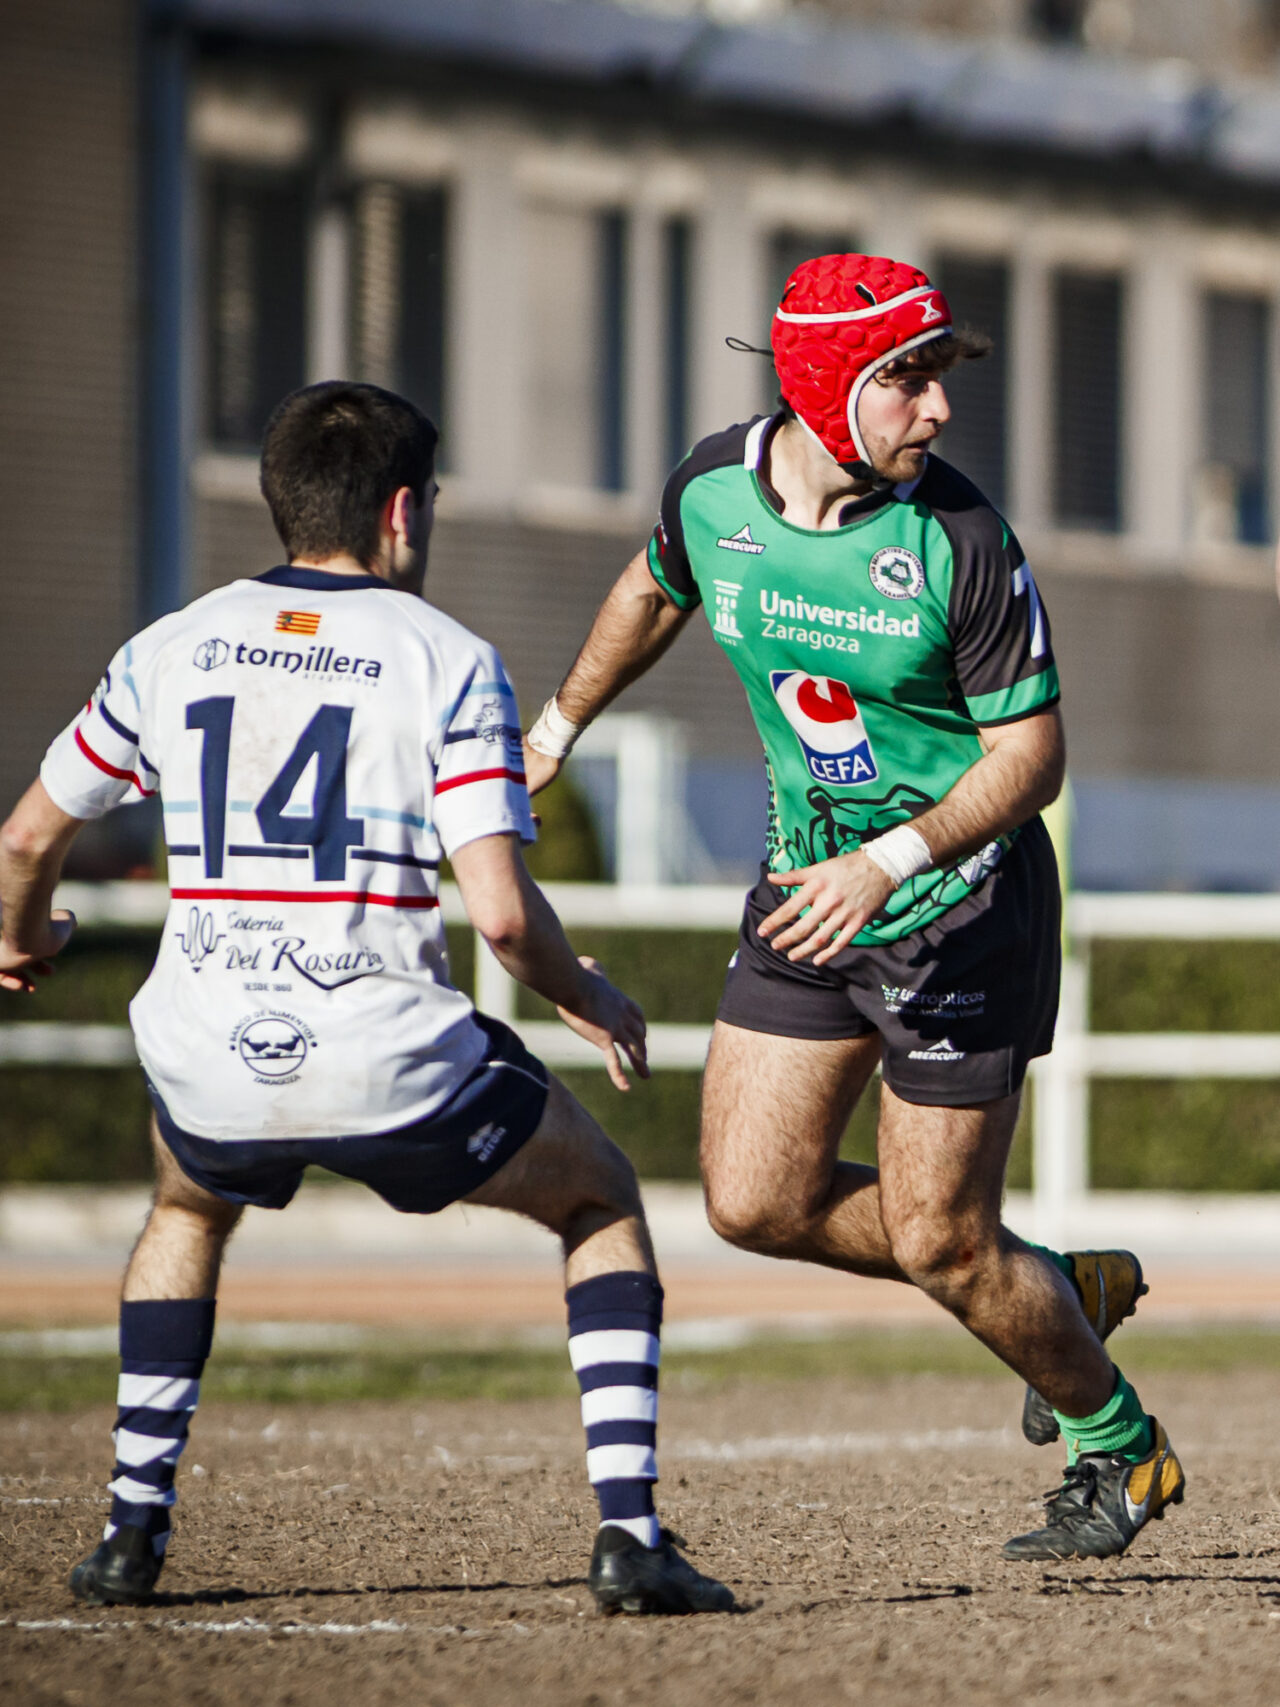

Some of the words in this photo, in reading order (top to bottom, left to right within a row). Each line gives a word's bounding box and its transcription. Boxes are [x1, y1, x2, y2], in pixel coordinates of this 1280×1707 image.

[718, 538, 764, 554] MERCURY
[760, 589, 920, 638] Universidad
[761, 618, 860, 653] Zaragoza
[235, 642, 382, 679] tornillera
[810, 754, 872, 781] CEFA
[185, 695, 365, 882] 14
[226, 944, 262, 970] Del
[908, 1050, 966, 1061] MERCURY
